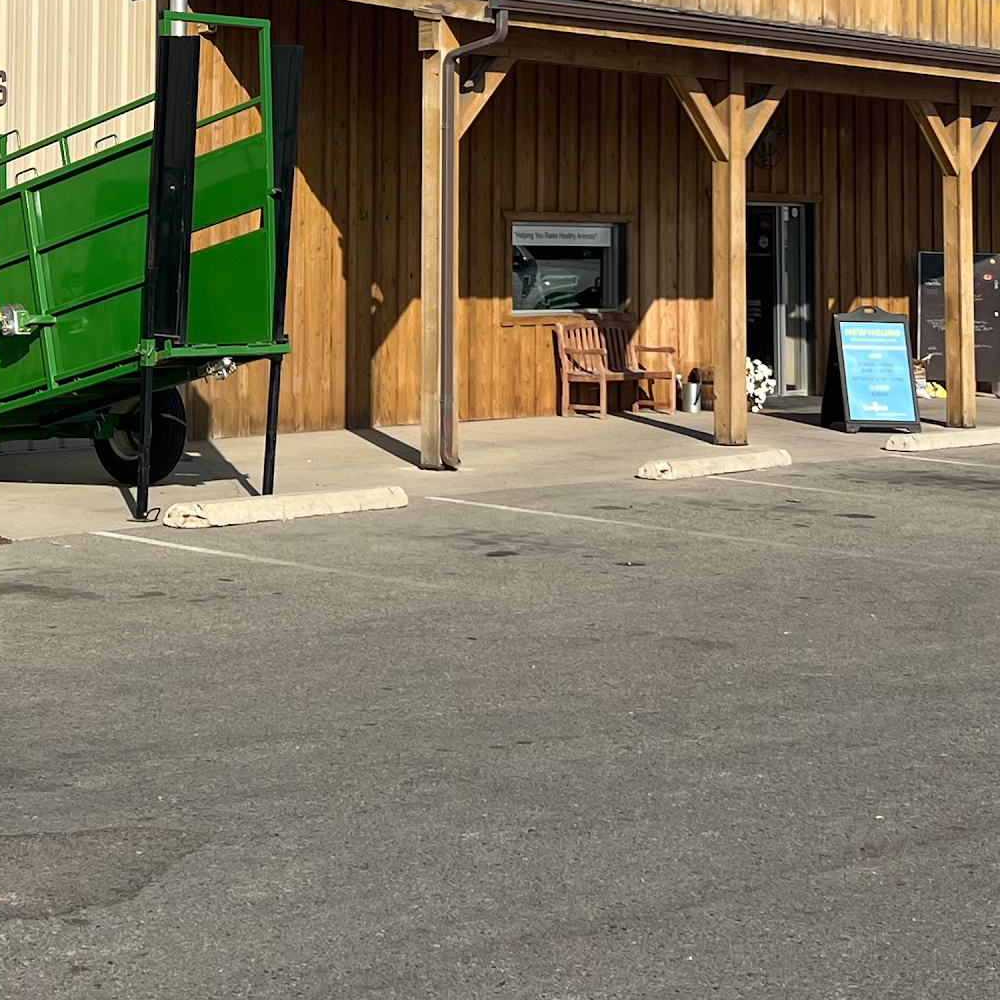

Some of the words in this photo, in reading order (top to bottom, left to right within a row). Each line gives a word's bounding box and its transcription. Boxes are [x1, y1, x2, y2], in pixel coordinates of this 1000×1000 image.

[545, 231, 558, 239] Raise
[559, 232, 575, 240] Healthy
[845, 328, 867, 336] NEW
[868, 329, 900, 337] HOURS
